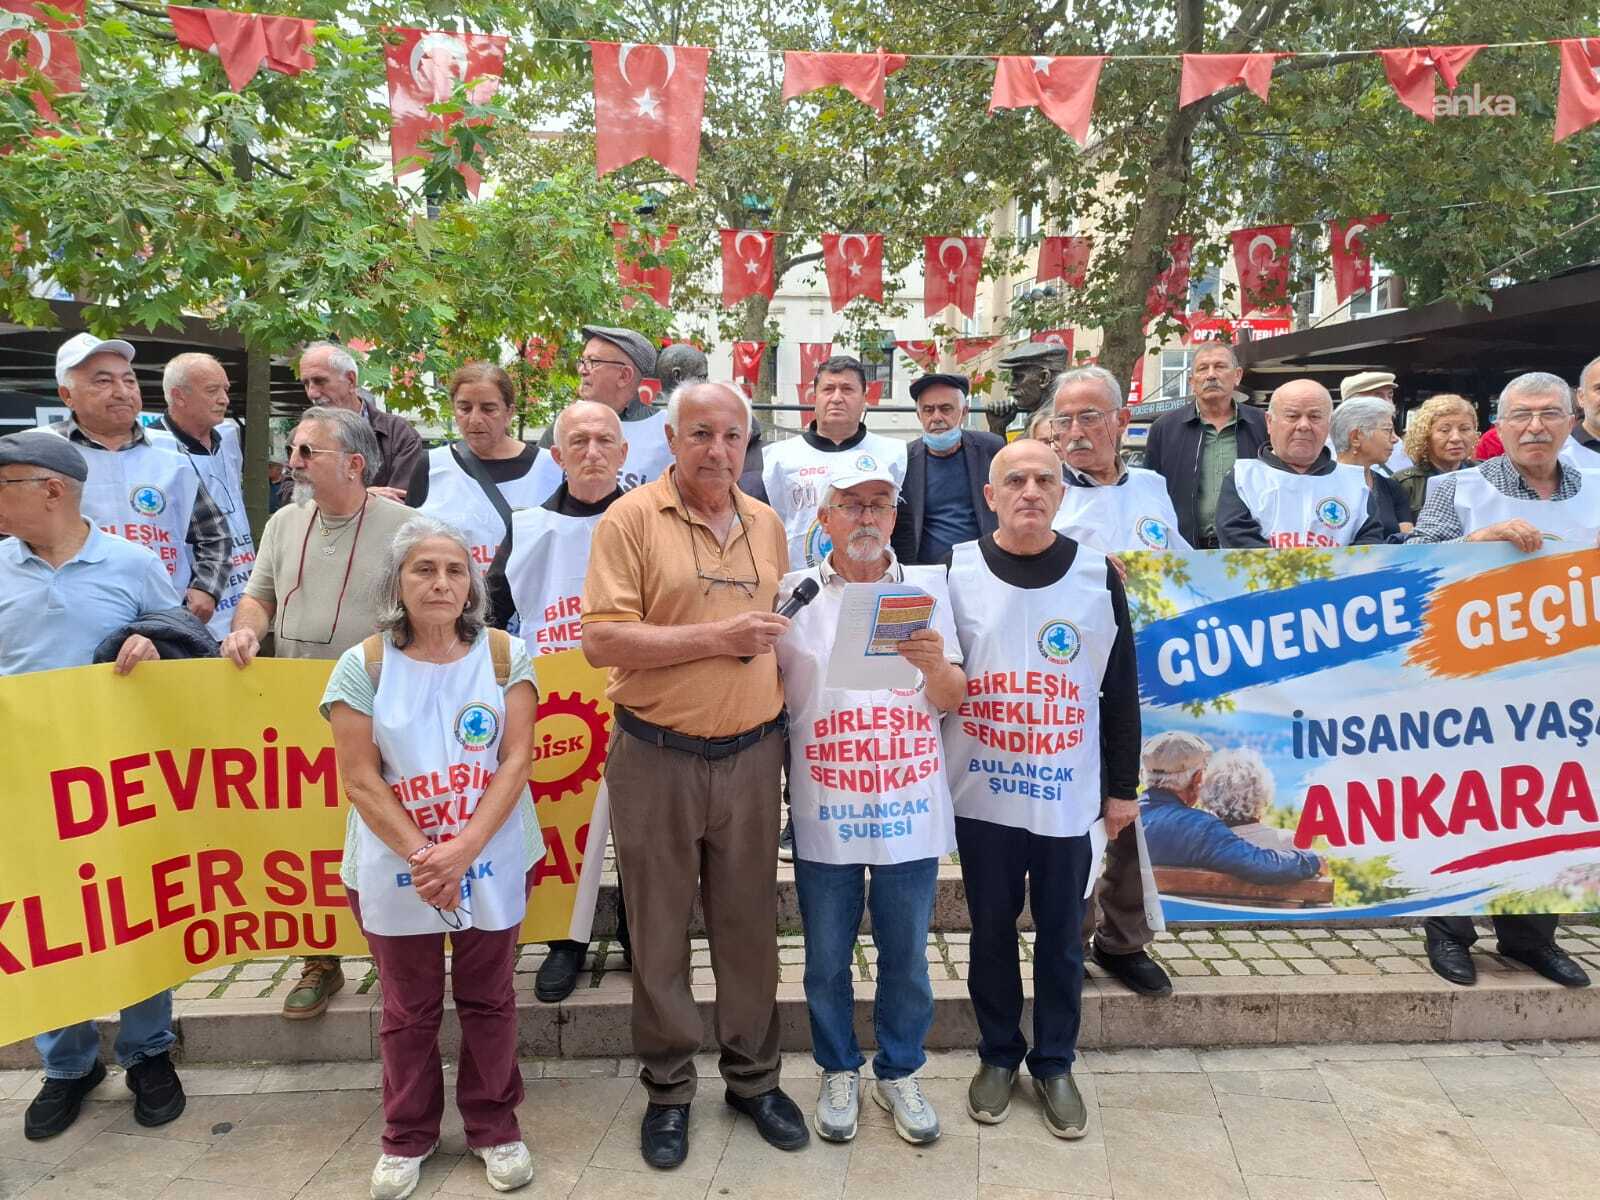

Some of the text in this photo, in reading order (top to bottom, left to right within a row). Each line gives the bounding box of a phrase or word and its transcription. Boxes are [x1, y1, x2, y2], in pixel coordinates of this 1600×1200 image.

[1230, 320, 1254, 329] T.C.
[1158, 587, 1412, 687] GÜVENCE
[967, 671, 1080, 702] BİRLEŞİK
[814, 705, 932, 738] BİRLEŞİK
[958, 701, 1085, 726] EMEKLİLER
[1292, 698, 1600, 760] İNSANCA YAŞ
[805, 737, 937, 763] EMEKLİLER
[962, 721, 1084, 755] SENDİKASI
[50, 727, 339, 841] DEVRİM
[810, 758, 939, 794] SENDİKASI
[969, 759, 1074, 782] BULANCAK
[989, 777, 1062, 801] ŞUBESİ
[819, 799, 929, 821] BULANCAK
[1293, 761, 1600, 850] ANKARA
[839, 816, 912, 843] ŞUBESİ
[184, 910, 337, 964] ORDU
